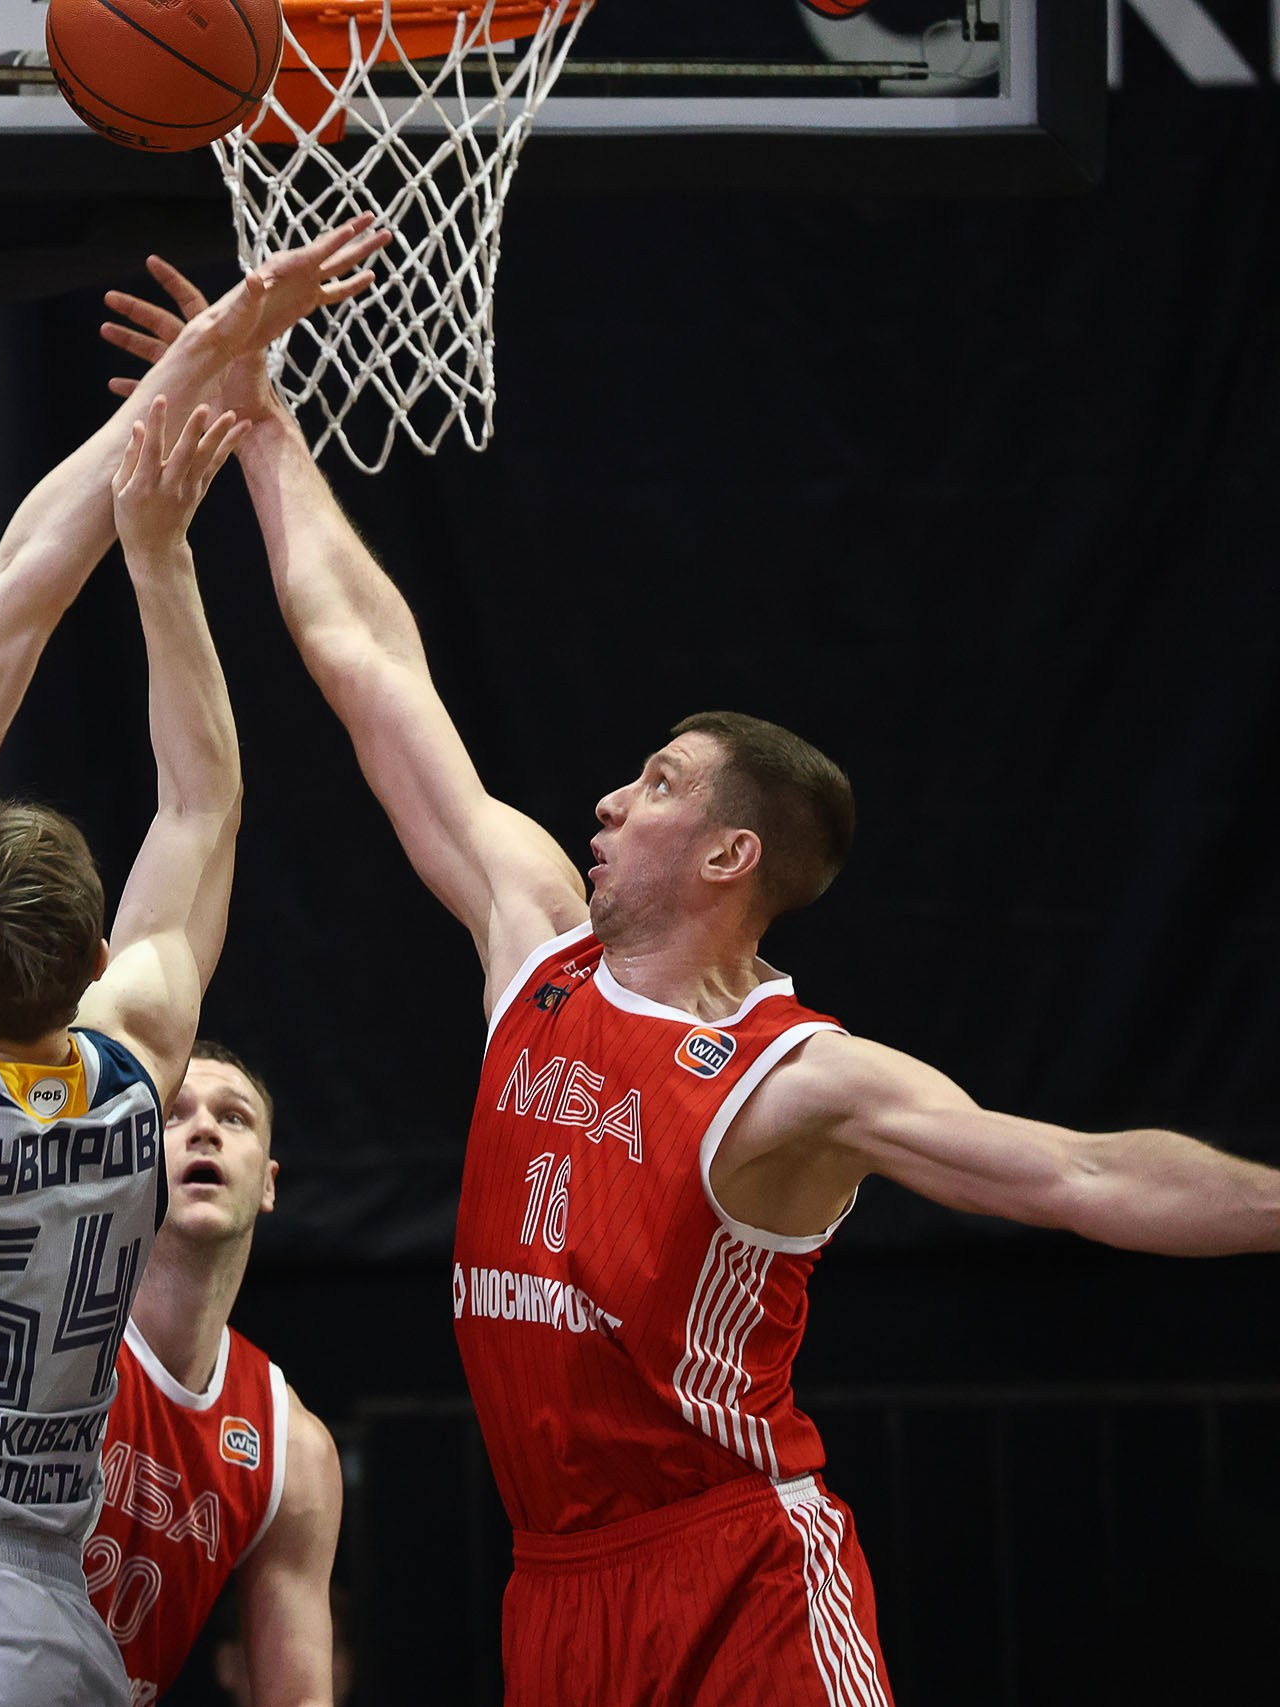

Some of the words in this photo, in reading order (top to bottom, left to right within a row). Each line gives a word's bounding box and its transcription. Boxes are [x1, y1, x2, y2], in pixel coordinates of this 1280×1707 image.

[692, 1038, 724, 1068] Win
[33, 1089, 62, 1104] РФБ
[497, 1048, 643, 1164] МБА
[520, 1151, 573, 1254] 16
[230, 1430, 258, 1458] Win
[83, 1535, 162, 1645] 20
